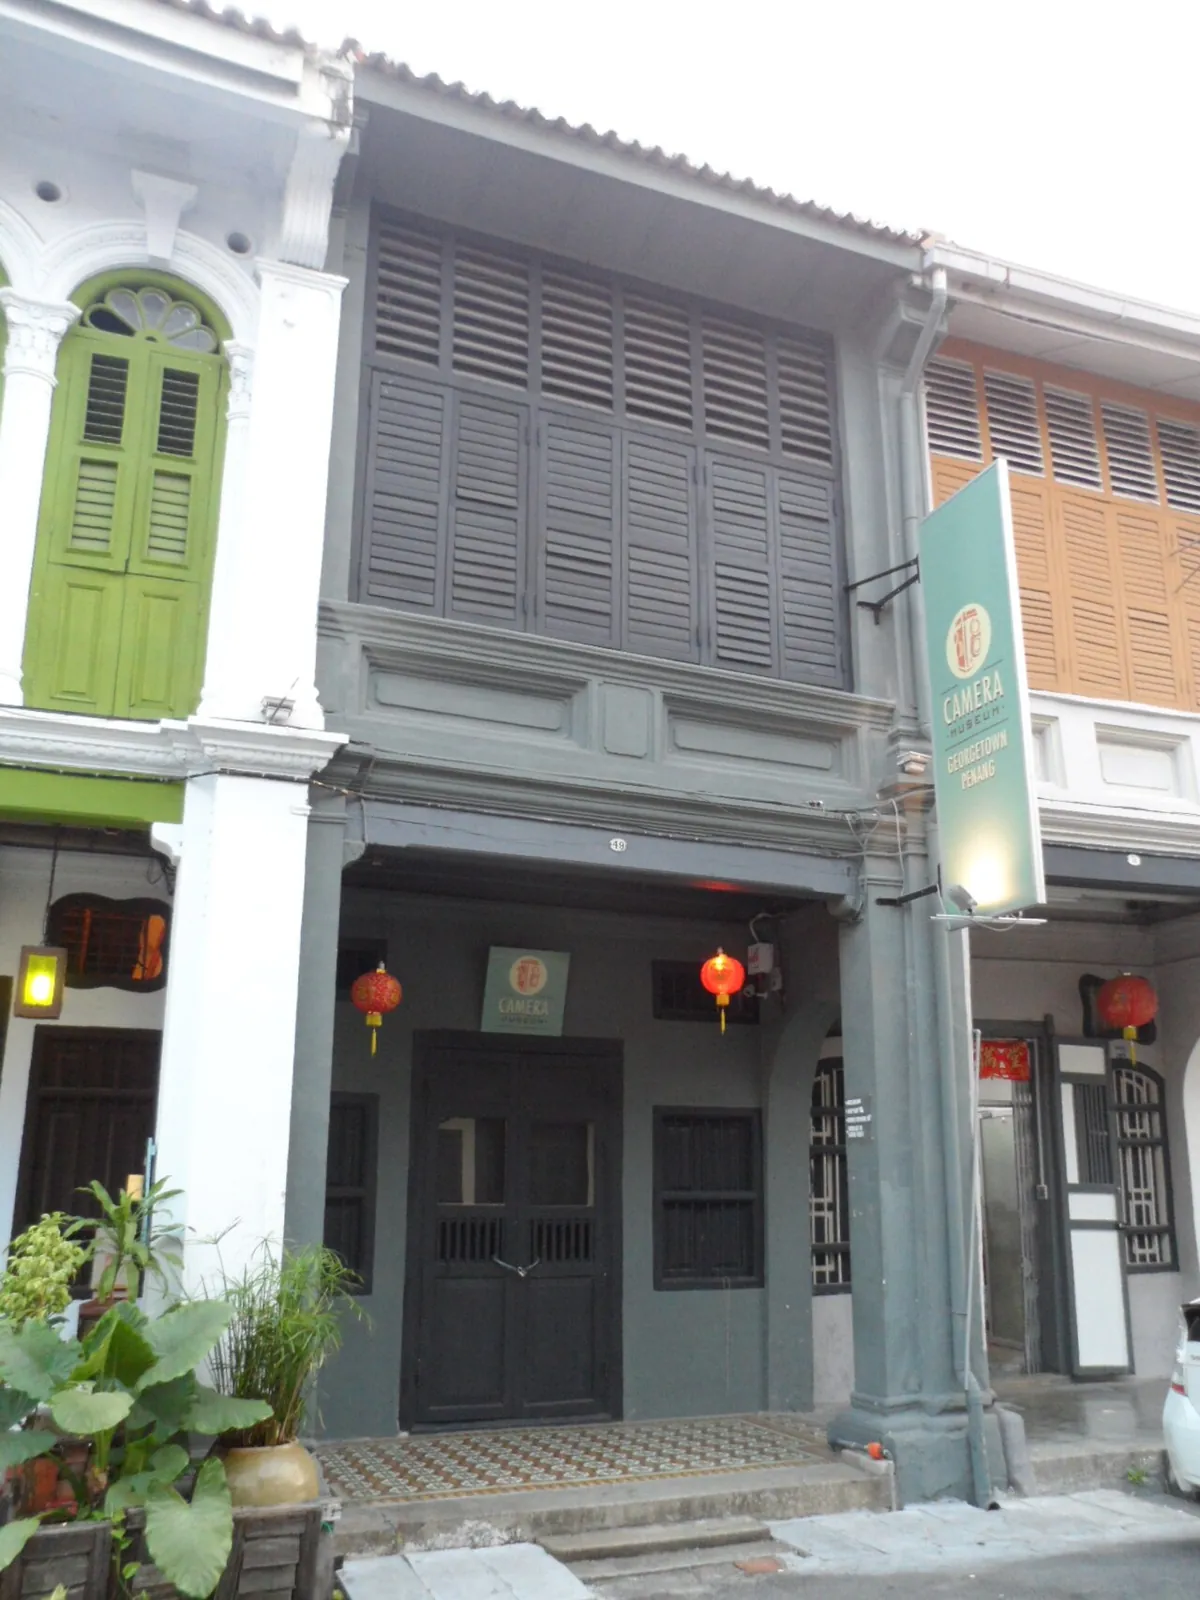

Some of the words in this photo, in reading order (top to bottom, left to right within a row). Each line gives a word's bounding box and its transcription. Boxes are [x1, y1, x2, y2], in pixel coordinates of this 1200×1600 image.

[943, 670, 1004, 725] CAMERA
[947, 729, 1008, 774] GEORGETOWN
[961, 759, 996, 790] PENANG
[498, 997, 549, 1016] CAMERA
